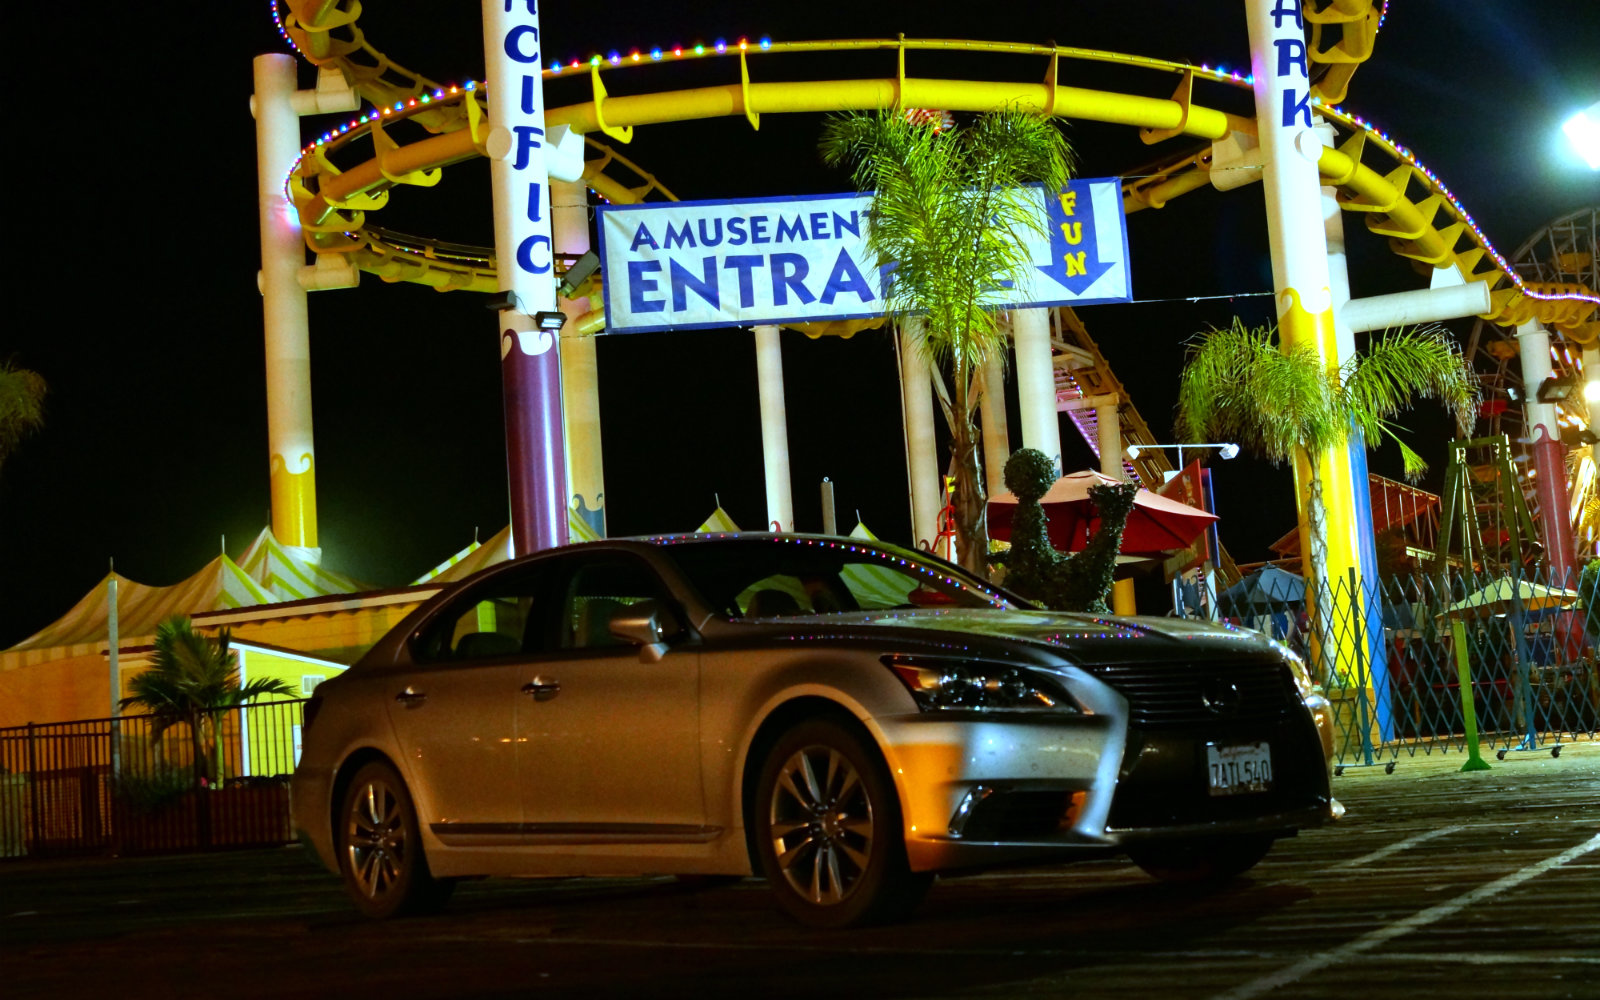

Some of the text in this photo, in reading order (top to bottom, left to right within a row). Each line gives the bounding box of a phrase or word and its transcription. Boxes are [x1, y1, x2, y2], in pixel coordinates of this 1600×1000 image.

[629, 209, 884, 252] AMUSEMEN
[1058, 190, 1087, 277] FUN
[627, 244, 1015, 314] ENTRA
